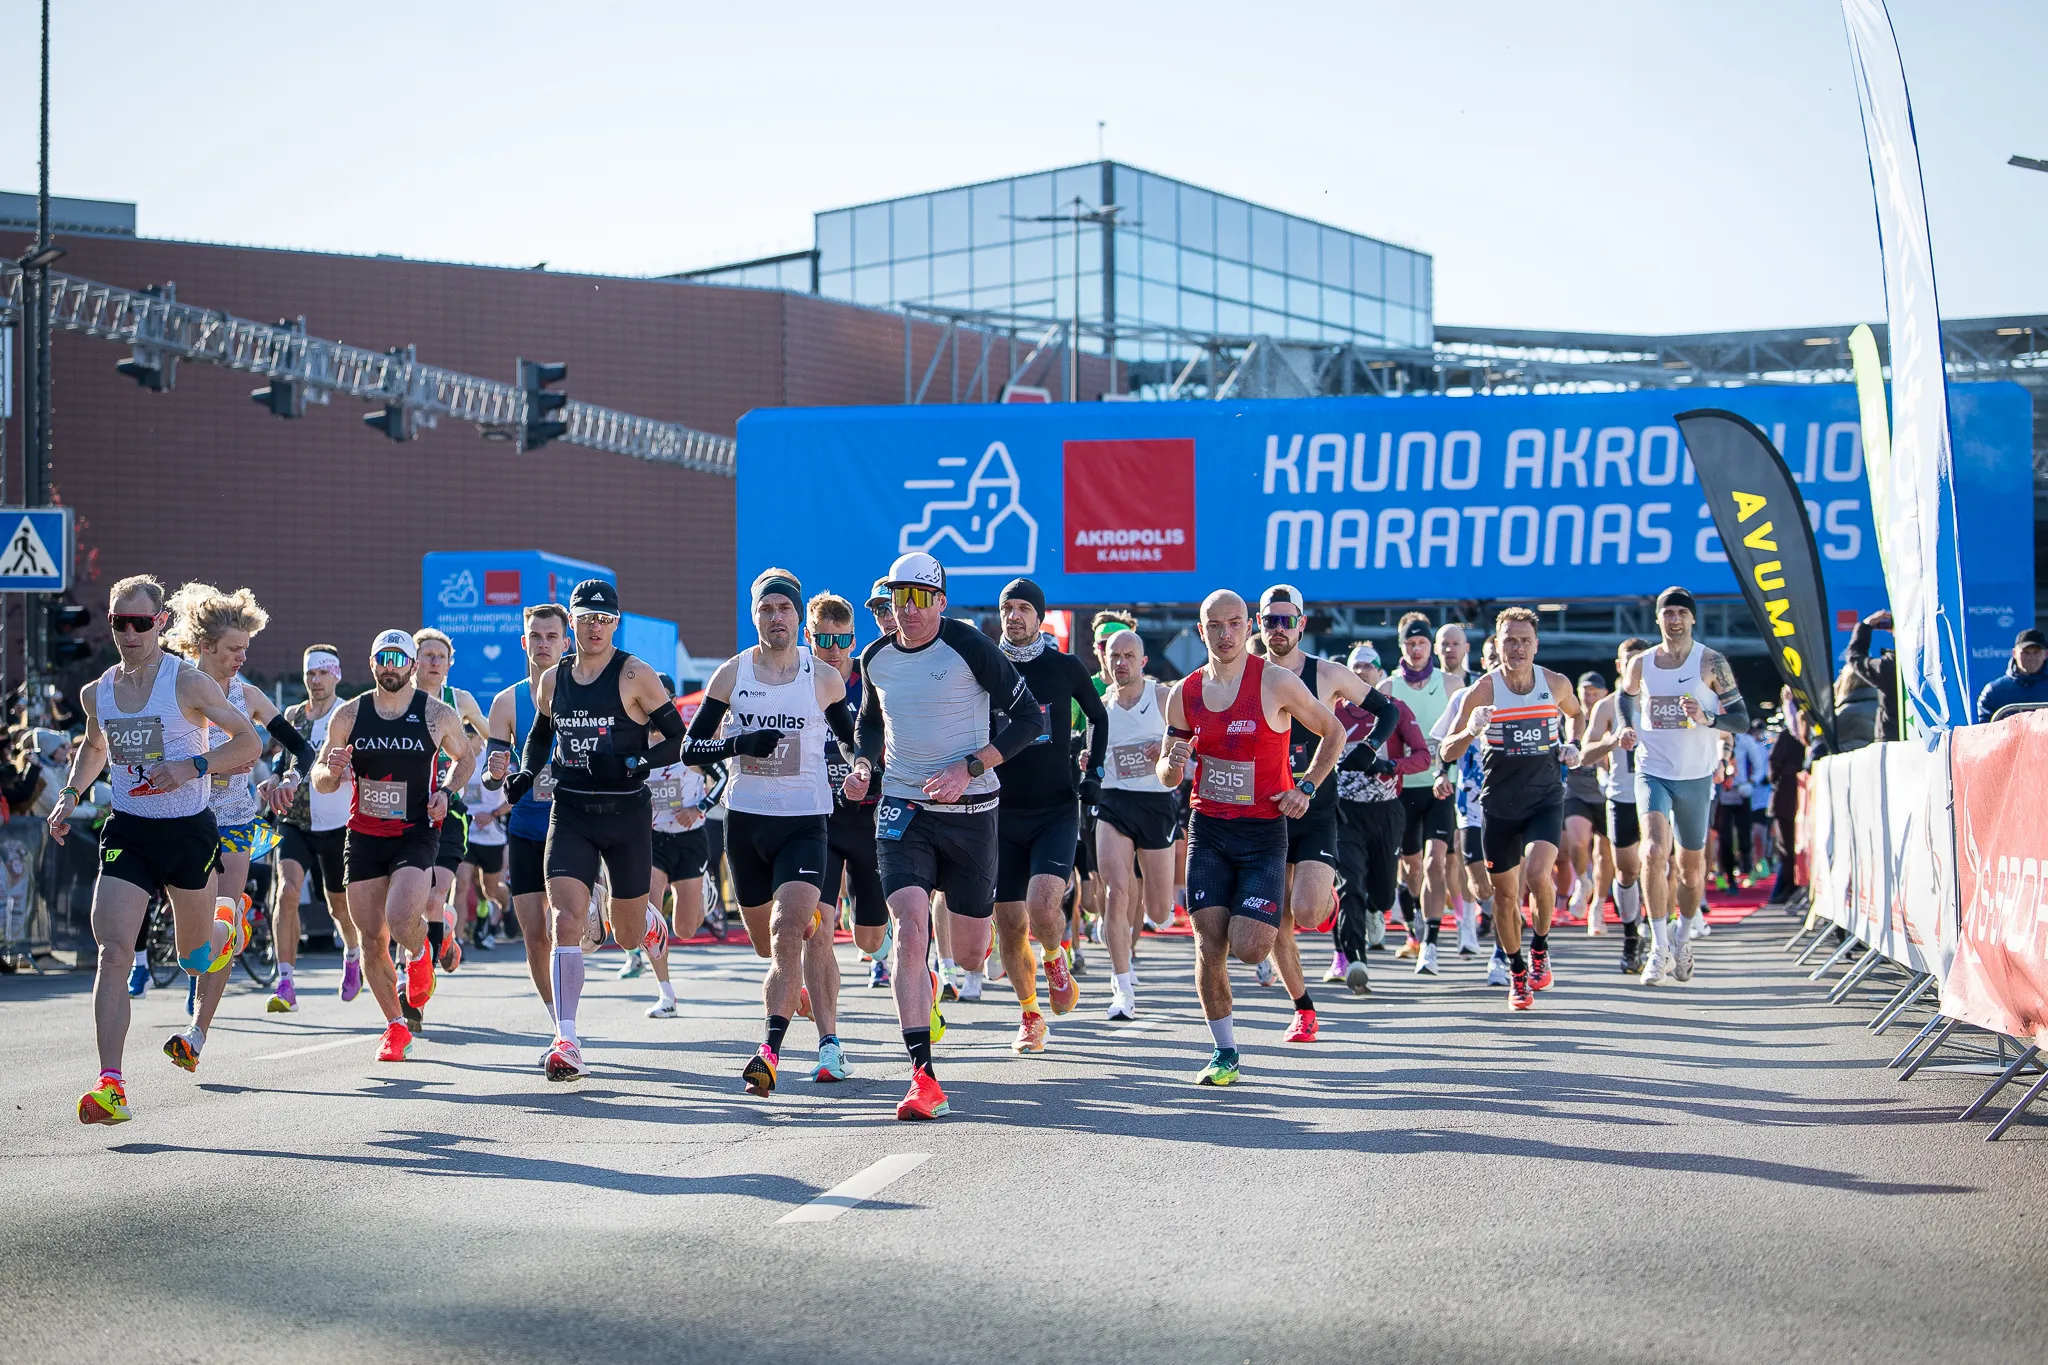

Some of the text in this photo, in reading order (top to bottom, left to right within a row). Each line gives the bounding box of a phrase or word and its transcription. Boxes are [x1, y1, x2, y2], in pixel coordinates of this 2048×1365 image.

[1263, 430, 1482, 494] KAUNO
[1504, 421, 1862, 490] AKROLIO
[1075, 527, 1185, 547] AKROPOLIS
[1263, 499, 1862, 571] MARATONAS 25
[1097, 548, 1163, 563] KAUNAS
[556, 717, 615, 728] EXCHANGE
[756, 713, 805, 729] voltas
[111, 729, 152, 747] 2497
[695, 739, 726, 747] NORD
[1513, 728, 1542, 743] 849
[355, 737, 425, 751] CANADA
[570, 737, 598, 752] 847
[693, 745, 725, 753] SECURITY
[1207, 768, 1244, 788] 2515
[363, 788, 400, 805] 2380
[1243, 900, 1261, 909] RUN
[1245, 896, 1270, 906] JUST
